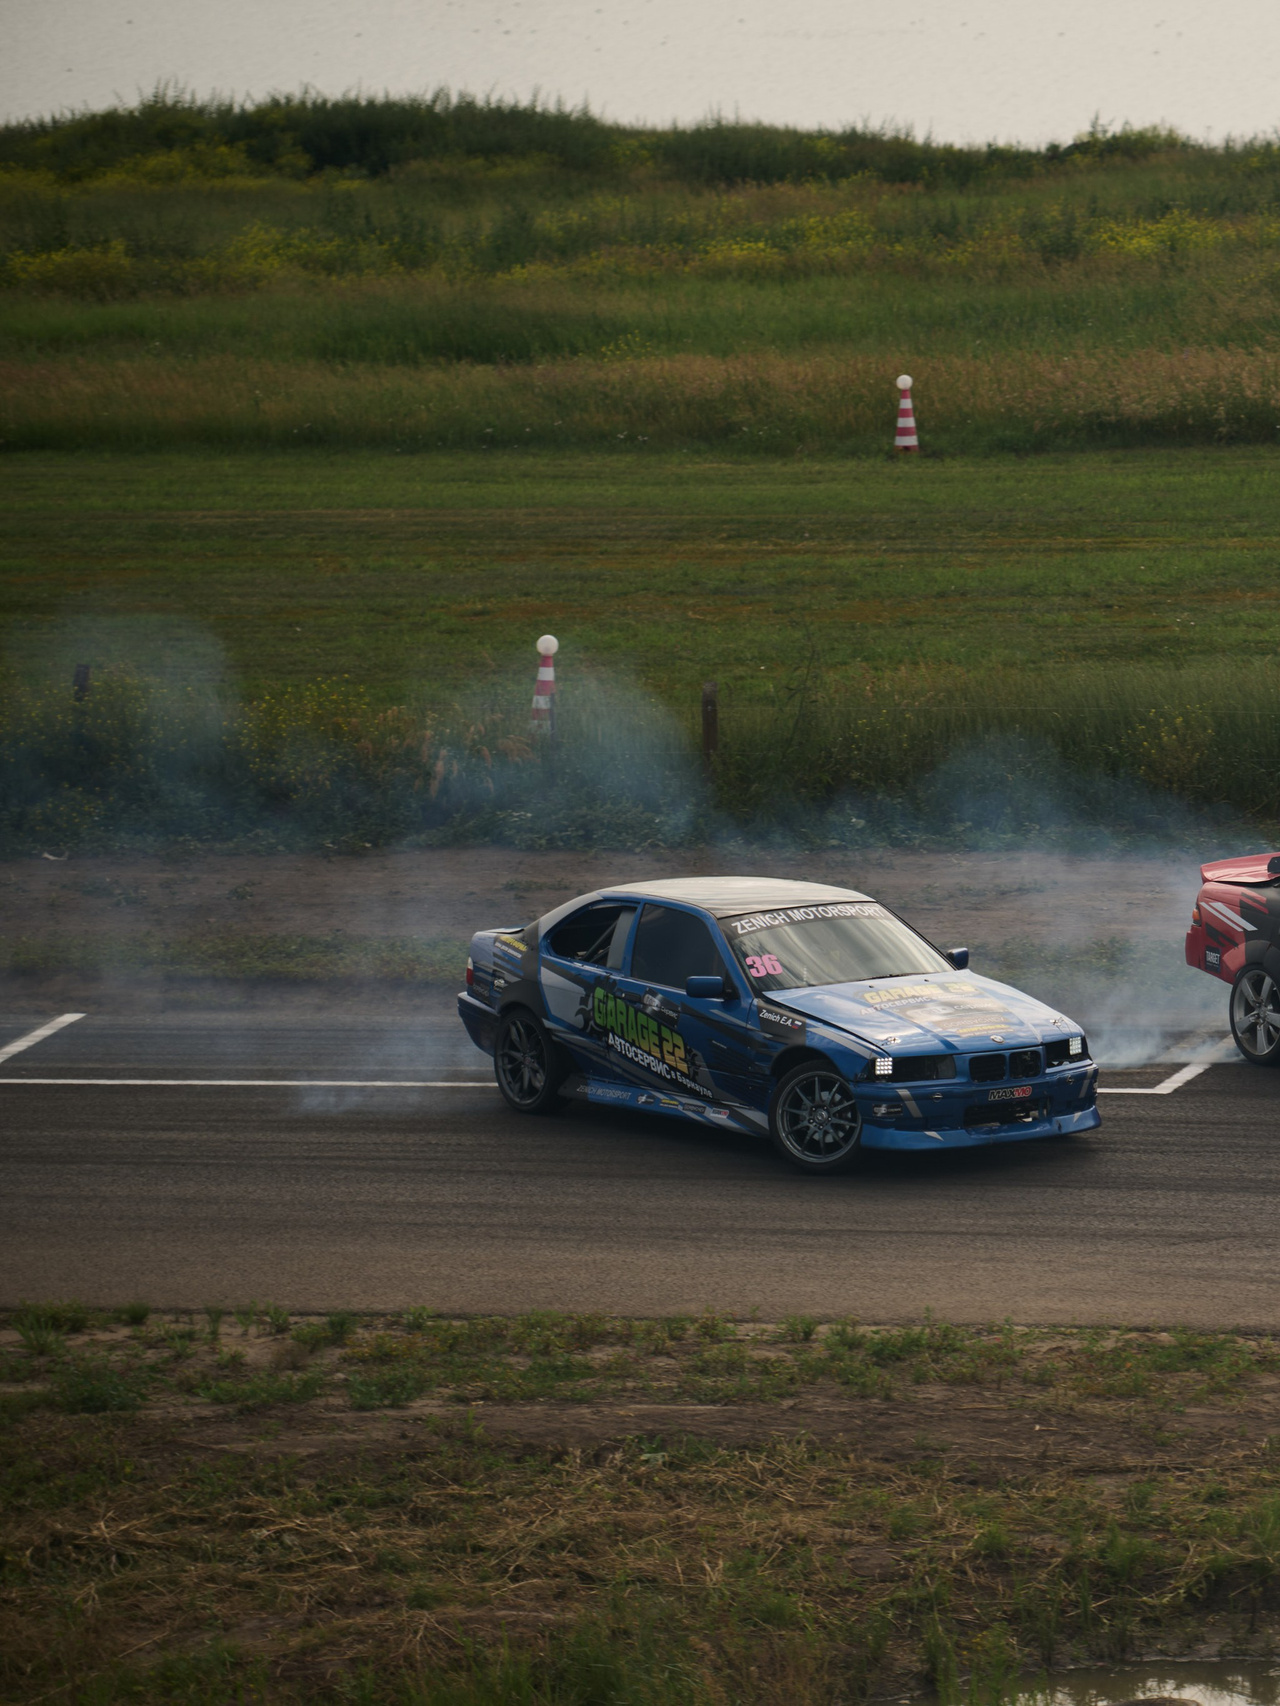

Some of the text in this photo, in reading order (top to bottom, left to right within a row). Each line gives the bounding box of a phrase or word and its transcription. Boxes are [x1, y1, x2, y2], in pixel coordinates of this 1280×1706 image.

[731, 905, 885, 934] ZENICH MOTORSPORT
[745, 954, 783, 978] 36
[863, 983, 943, 1004] GARAGE
[759, 1009, 780, 1023] Zenich
[594, 986, 689, 1075] GARAGE 22
[608, 1032, 671, 1079] АВТОСЕРВИС
[677, 1073, 713, 1098] Барнауле
